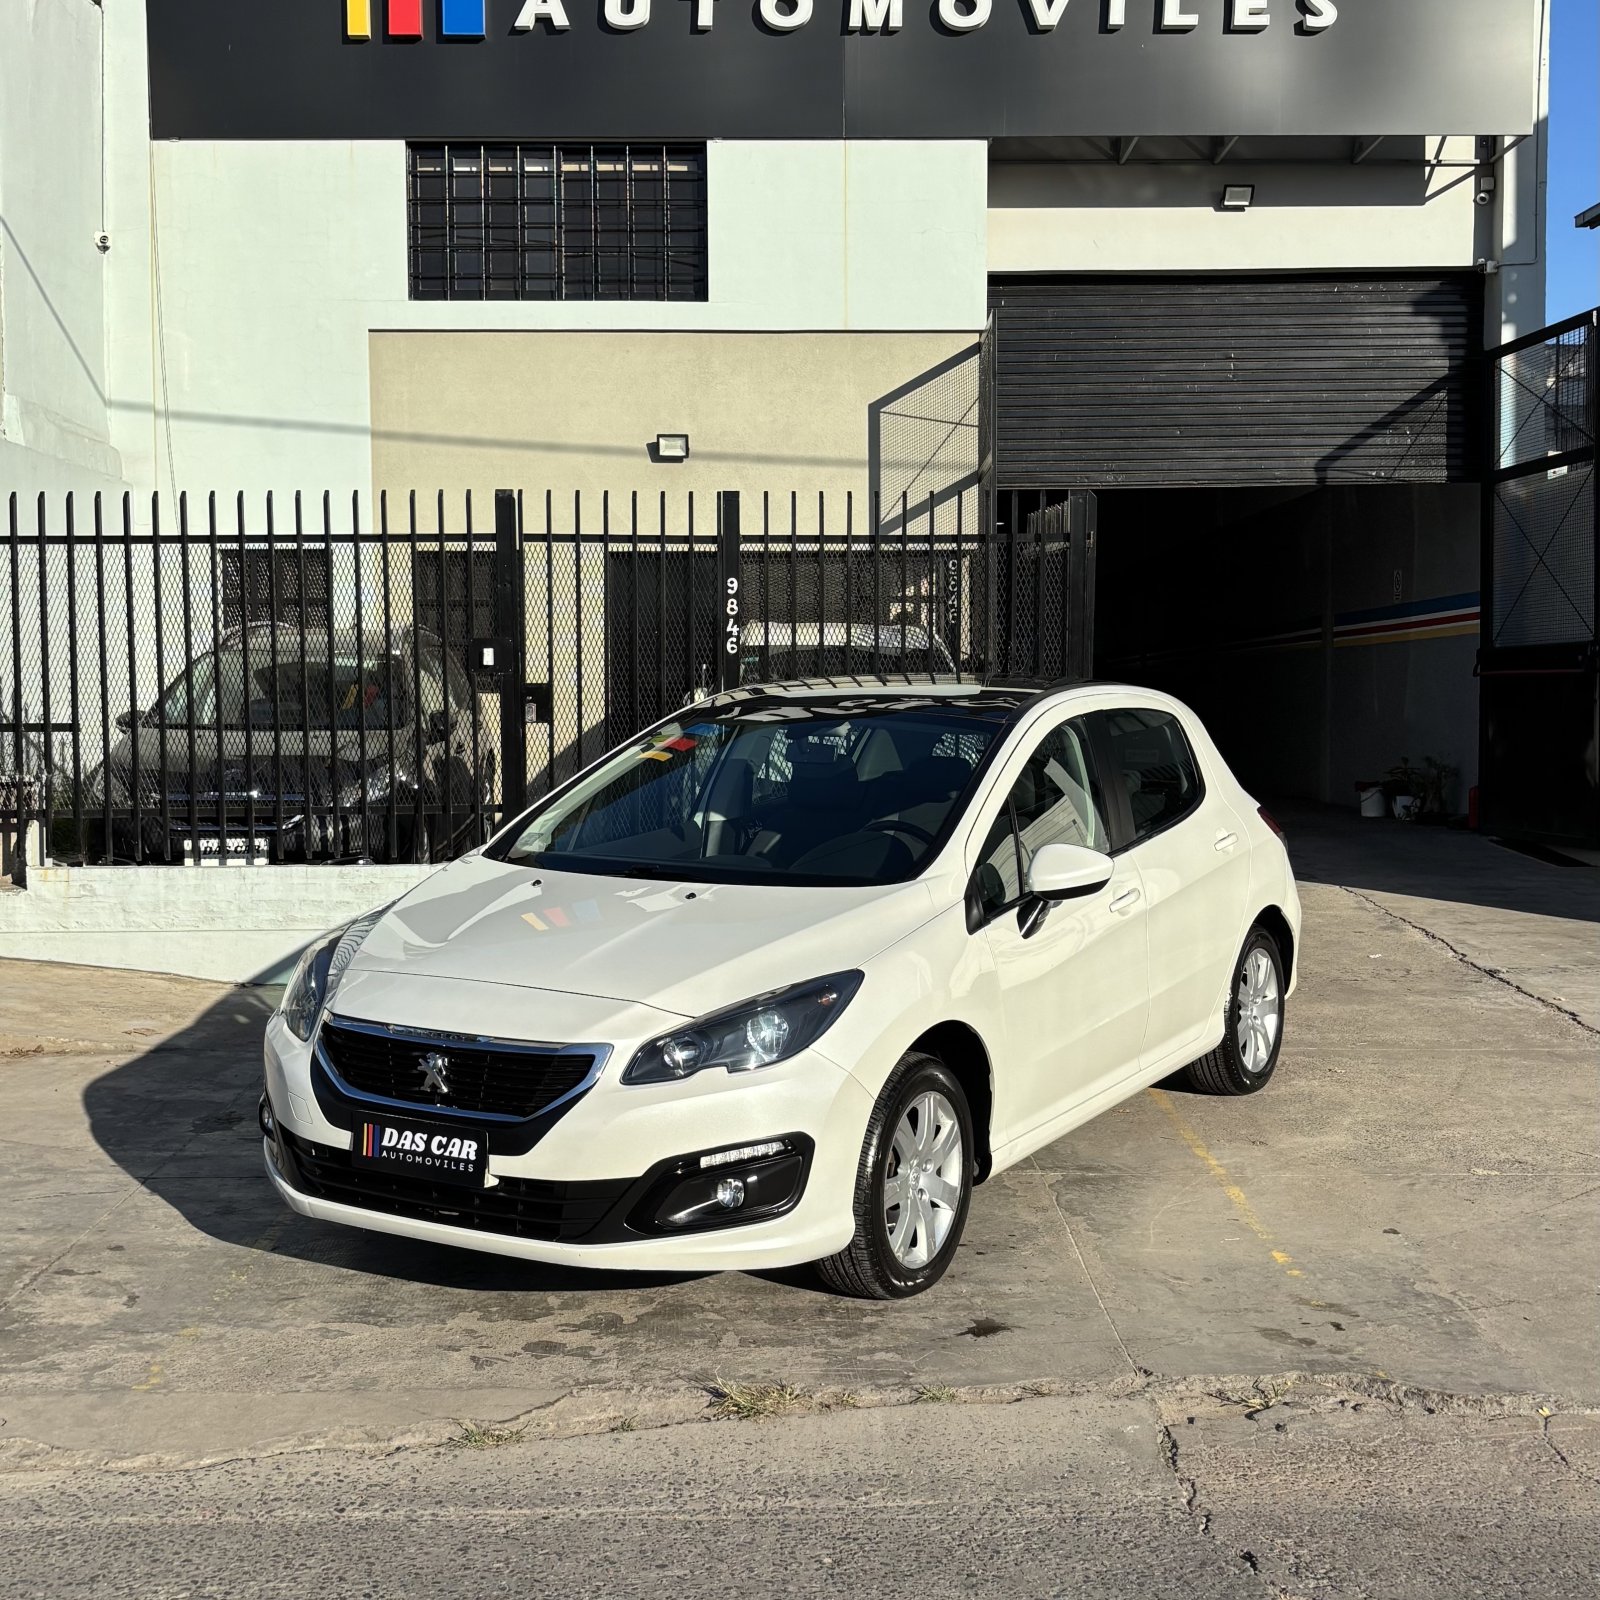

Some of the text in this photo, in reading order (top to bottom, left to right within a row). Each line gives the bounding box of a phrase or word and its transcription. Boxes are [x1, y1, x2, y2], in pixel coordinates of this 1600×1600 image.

[513, 0, 1339, 31] AUTOMOVILES
[726, 577, 739, 654] 9846
[381, 1127, 478, 1160] DAS CAR
[381, 1150, 474, 1172] AUTOMOVILES
